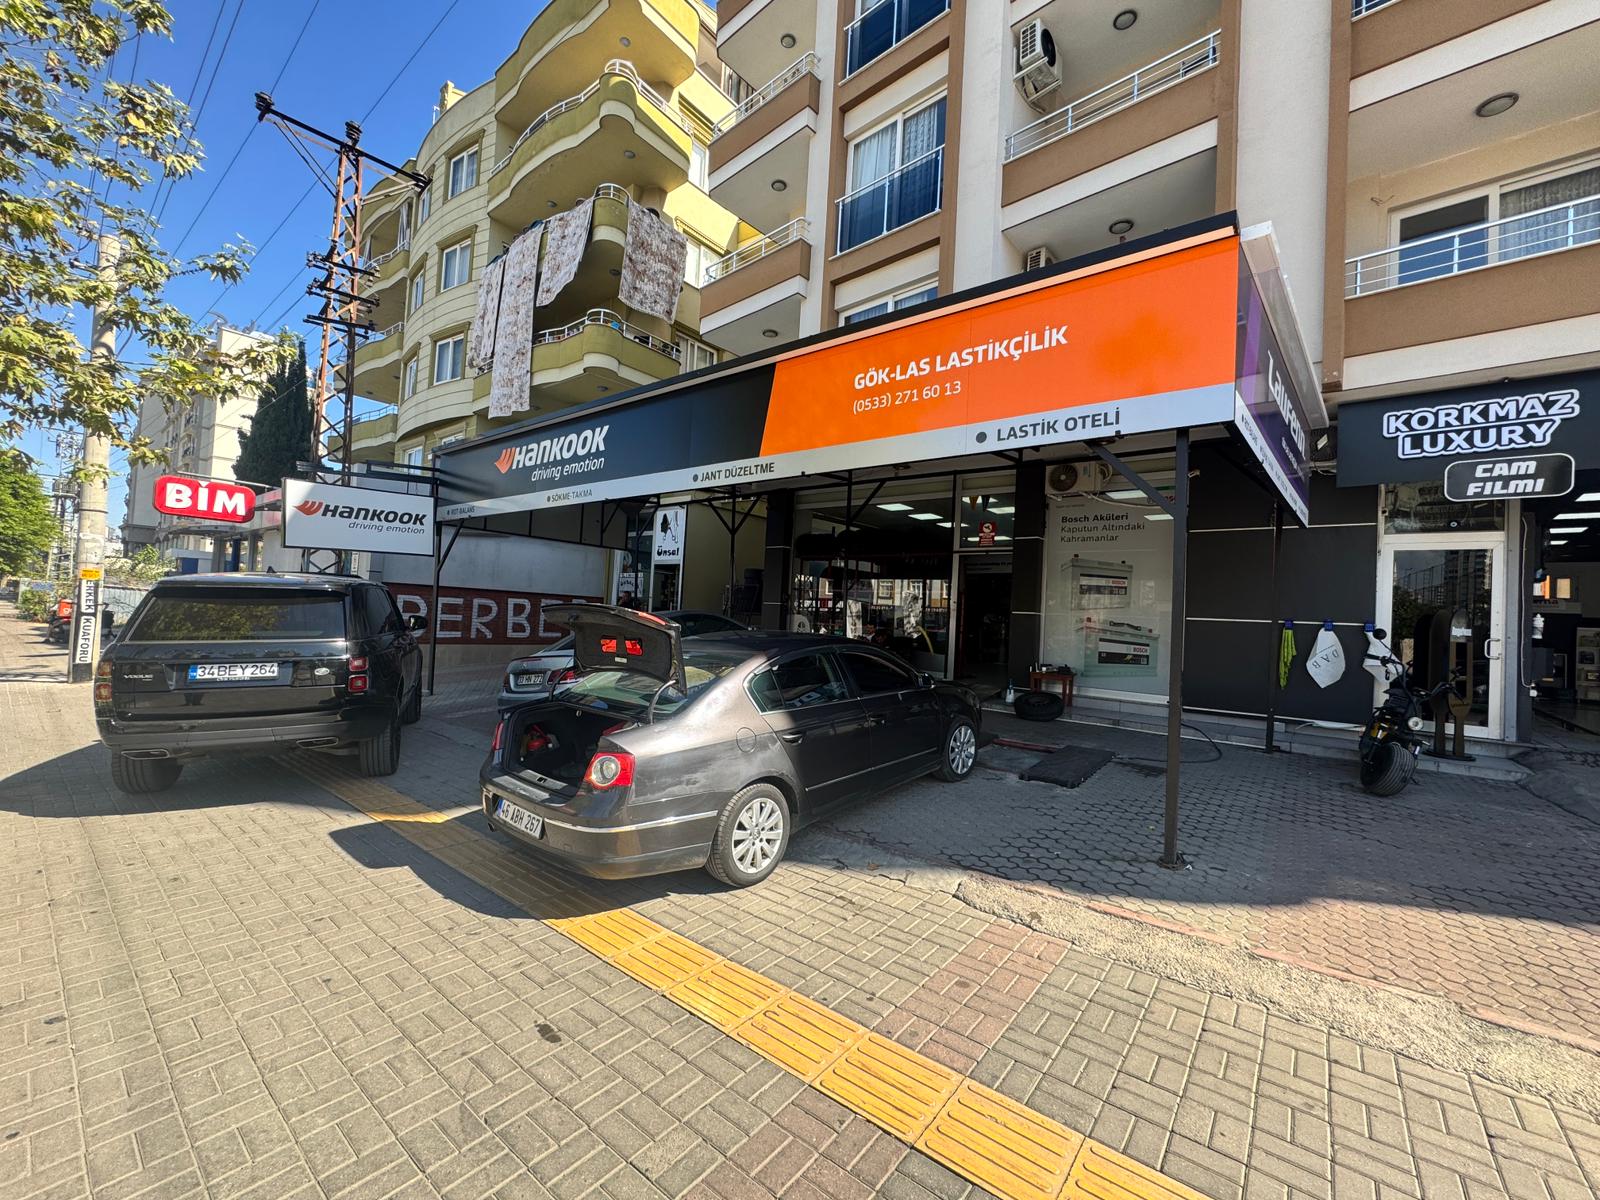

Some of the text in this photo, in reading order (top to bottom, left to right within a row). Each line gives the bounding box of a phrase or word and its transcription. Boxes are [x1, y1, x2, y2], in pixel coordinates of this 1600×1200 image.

[854, 325, 1068, 389] GÖK-LAS LASTİKÇİLİK
[853, 381, 961, 415] (0533) 271 60 13
[1387, 391, 1576, 434] KORKMAZ
[996, 407, 1120, 442] LASTİK OTELİ
[1402, 420, 1553, 455] LUXURY
[531, 457, 605, 482] driving emotion
[700, 462, 775, 482] JANT DÜZELTME
[1475, 460, 1537, 478] CAM
[1061, 512, 1129, 523] Bosch Aküleri
[348, 521, 425, 535] driving emotion
[1061, 524, 1098, 534] Kaputun
[1060, 534, 1119, 543] Kahramanlar
[397, 594, 587, 639] BERBE
[198, 665, 215, 677] 34
[217, 664, 248, 677] BEY
[250, 663, 276, 676] 264
[525, 814, 540, 833] 267
